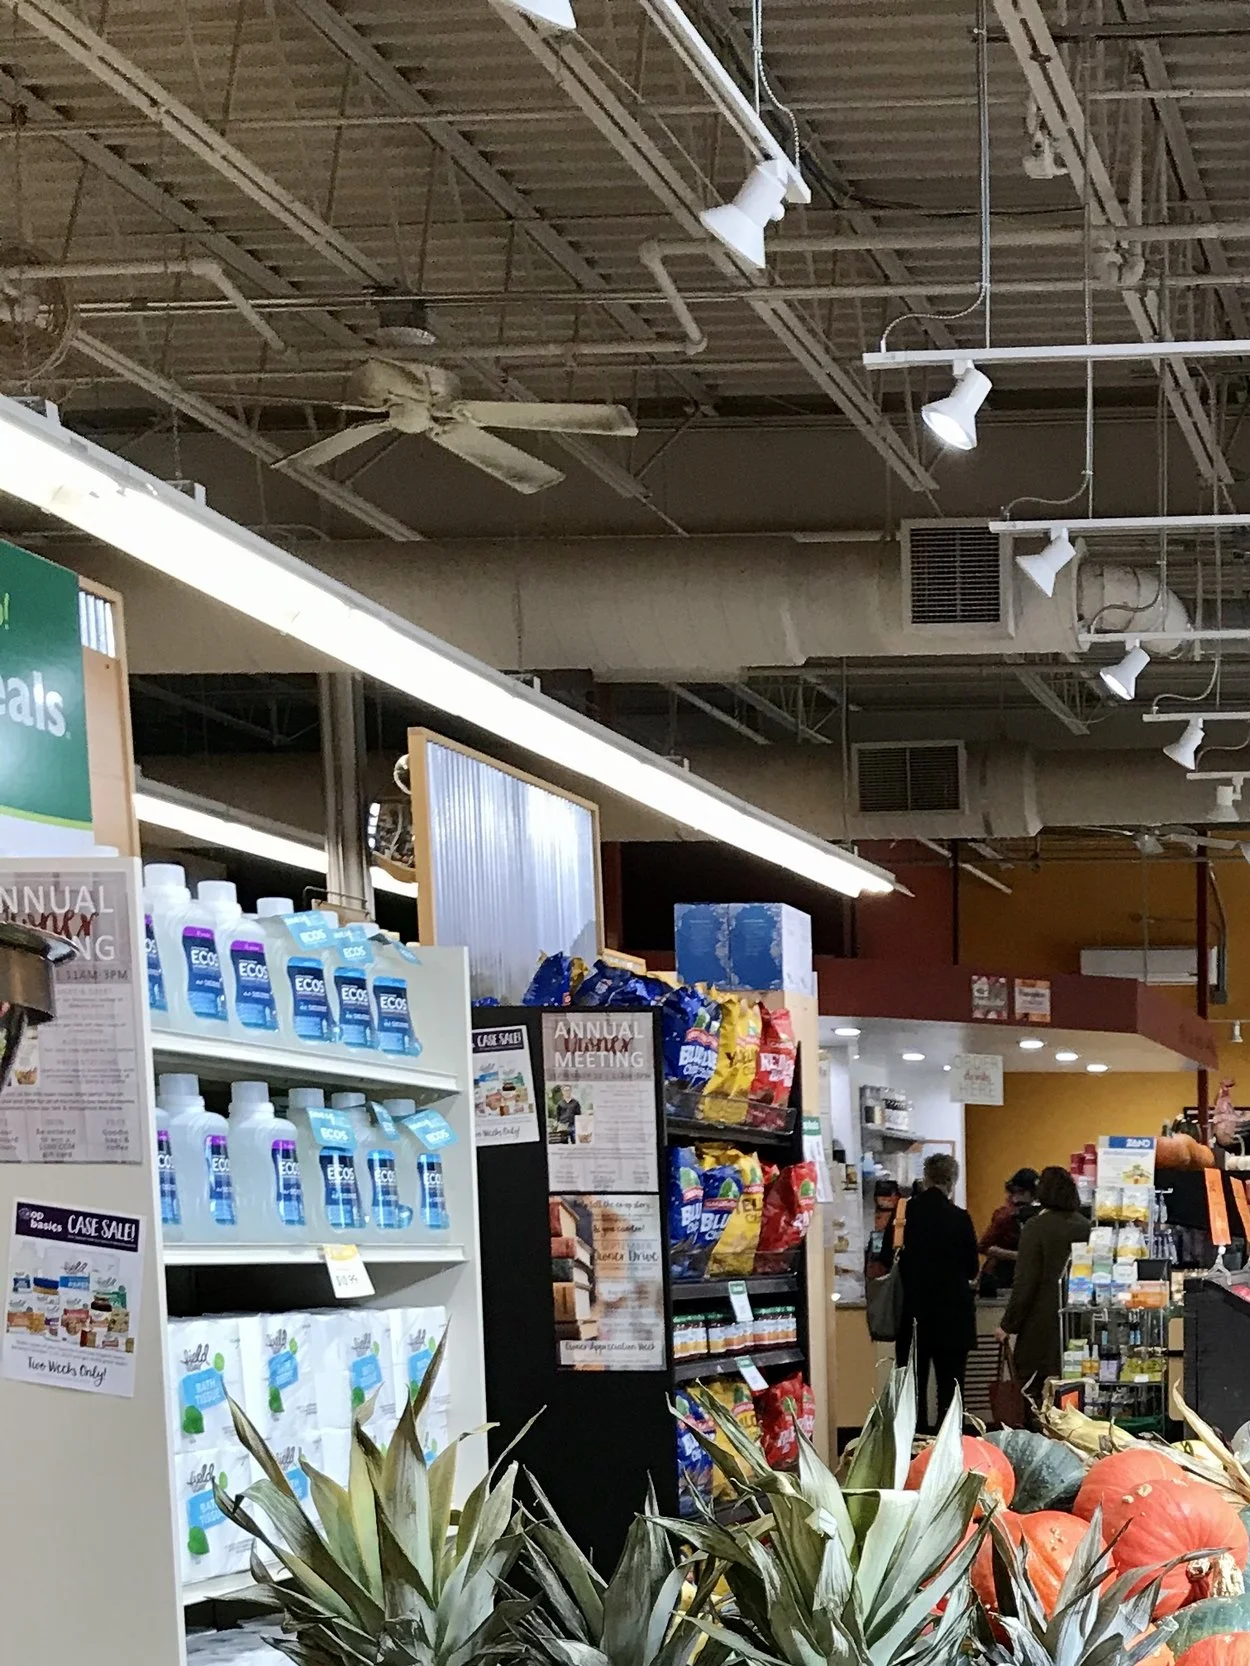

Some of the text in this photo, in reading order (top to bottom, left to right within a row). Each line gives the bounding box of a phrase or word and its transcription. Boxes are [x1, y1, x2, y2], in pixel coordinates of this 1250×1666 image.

[0, 670, 65, 738] als
[191, 950, 218, 967] ECOS
[239, 962, 268, 979] ECOS
[295, 978, 325, 993] ECOS
[341, 987, 368, 1002] ECOS
[380, 995, 407, 1009] ECOS
[554, 1021, 644, 1039] ANNUAL
[477, 1034, 498, 1048] CASE
[554, 1051, 645, 1068] MEETING
[1126, 1138, 1151, 1147] ZAND
[327, 1167, 355, 1181] ECOS
[31, 1220, 63, 1233] basics
[68, 1215, 99, 1237] CASE
[101, 1218, 136, 1242] SALE!
[700, 1212, 731, 1232] BLU
[28, 1356, 107, 1388] Two Weeks Only!
